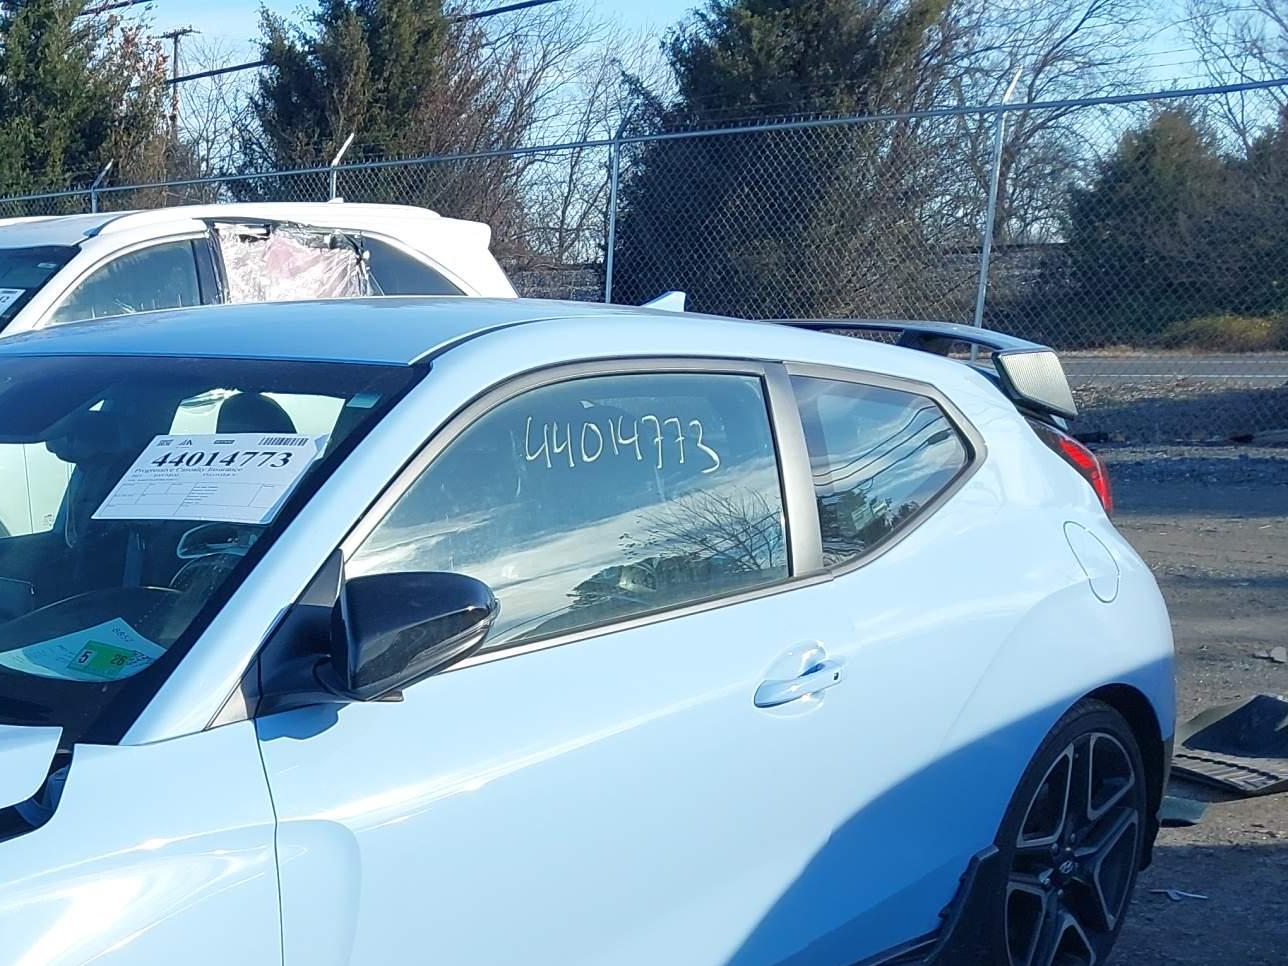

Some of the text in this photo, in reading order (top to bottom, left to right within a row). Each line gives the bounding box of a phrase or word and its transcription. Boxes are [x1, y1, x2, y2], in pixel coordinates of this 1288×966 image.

[525, 415, 721, 474] 44014773
[151, 450, 294, 468] 44014773
[78, 651, 91, 664] 5
